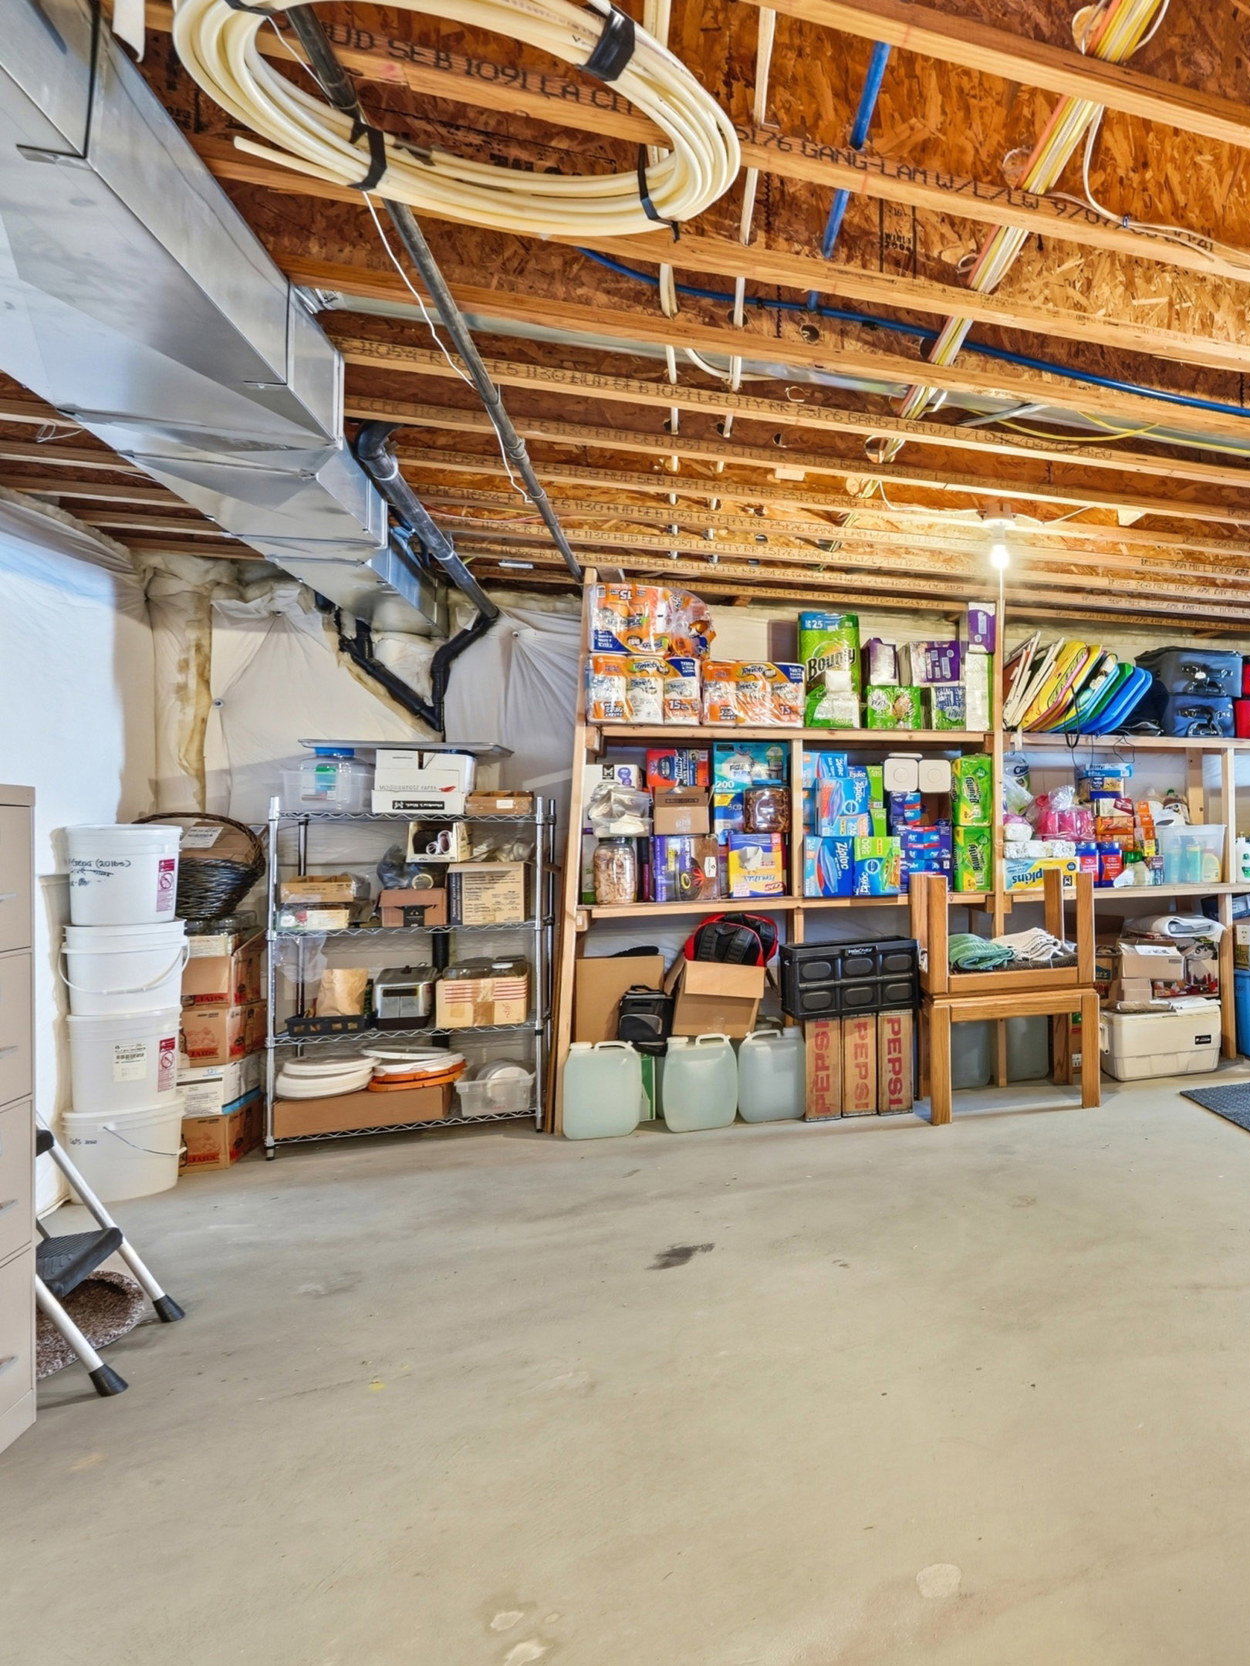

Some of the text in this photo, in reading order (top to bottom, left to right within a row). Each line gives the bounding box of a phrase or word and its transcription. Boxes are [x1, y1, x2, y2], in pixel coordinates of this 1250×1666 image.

[387, 37, 453, 72] SEB
[465, 56, 528, 90] 1091
[540, 76, 581, 105] LA
[590, 88, 634, 116] CIT
[734, 122, 793, 153] 5176
[800, 140, 928, 186] GANG-LAM
[811, 619, 824, 629] 25
[806, 646, 856, 682] Bounty
[715, 780, 735, 789] 200
[836, 841, 849, 870] Ziploc
[1011, 867, 1043, 885] pkins
[814, 1020, 831, 1114] PEPSI
[853, 1021, 870, 1110] PEPSI
[886, 1016, 904, 1108] PEPSI
